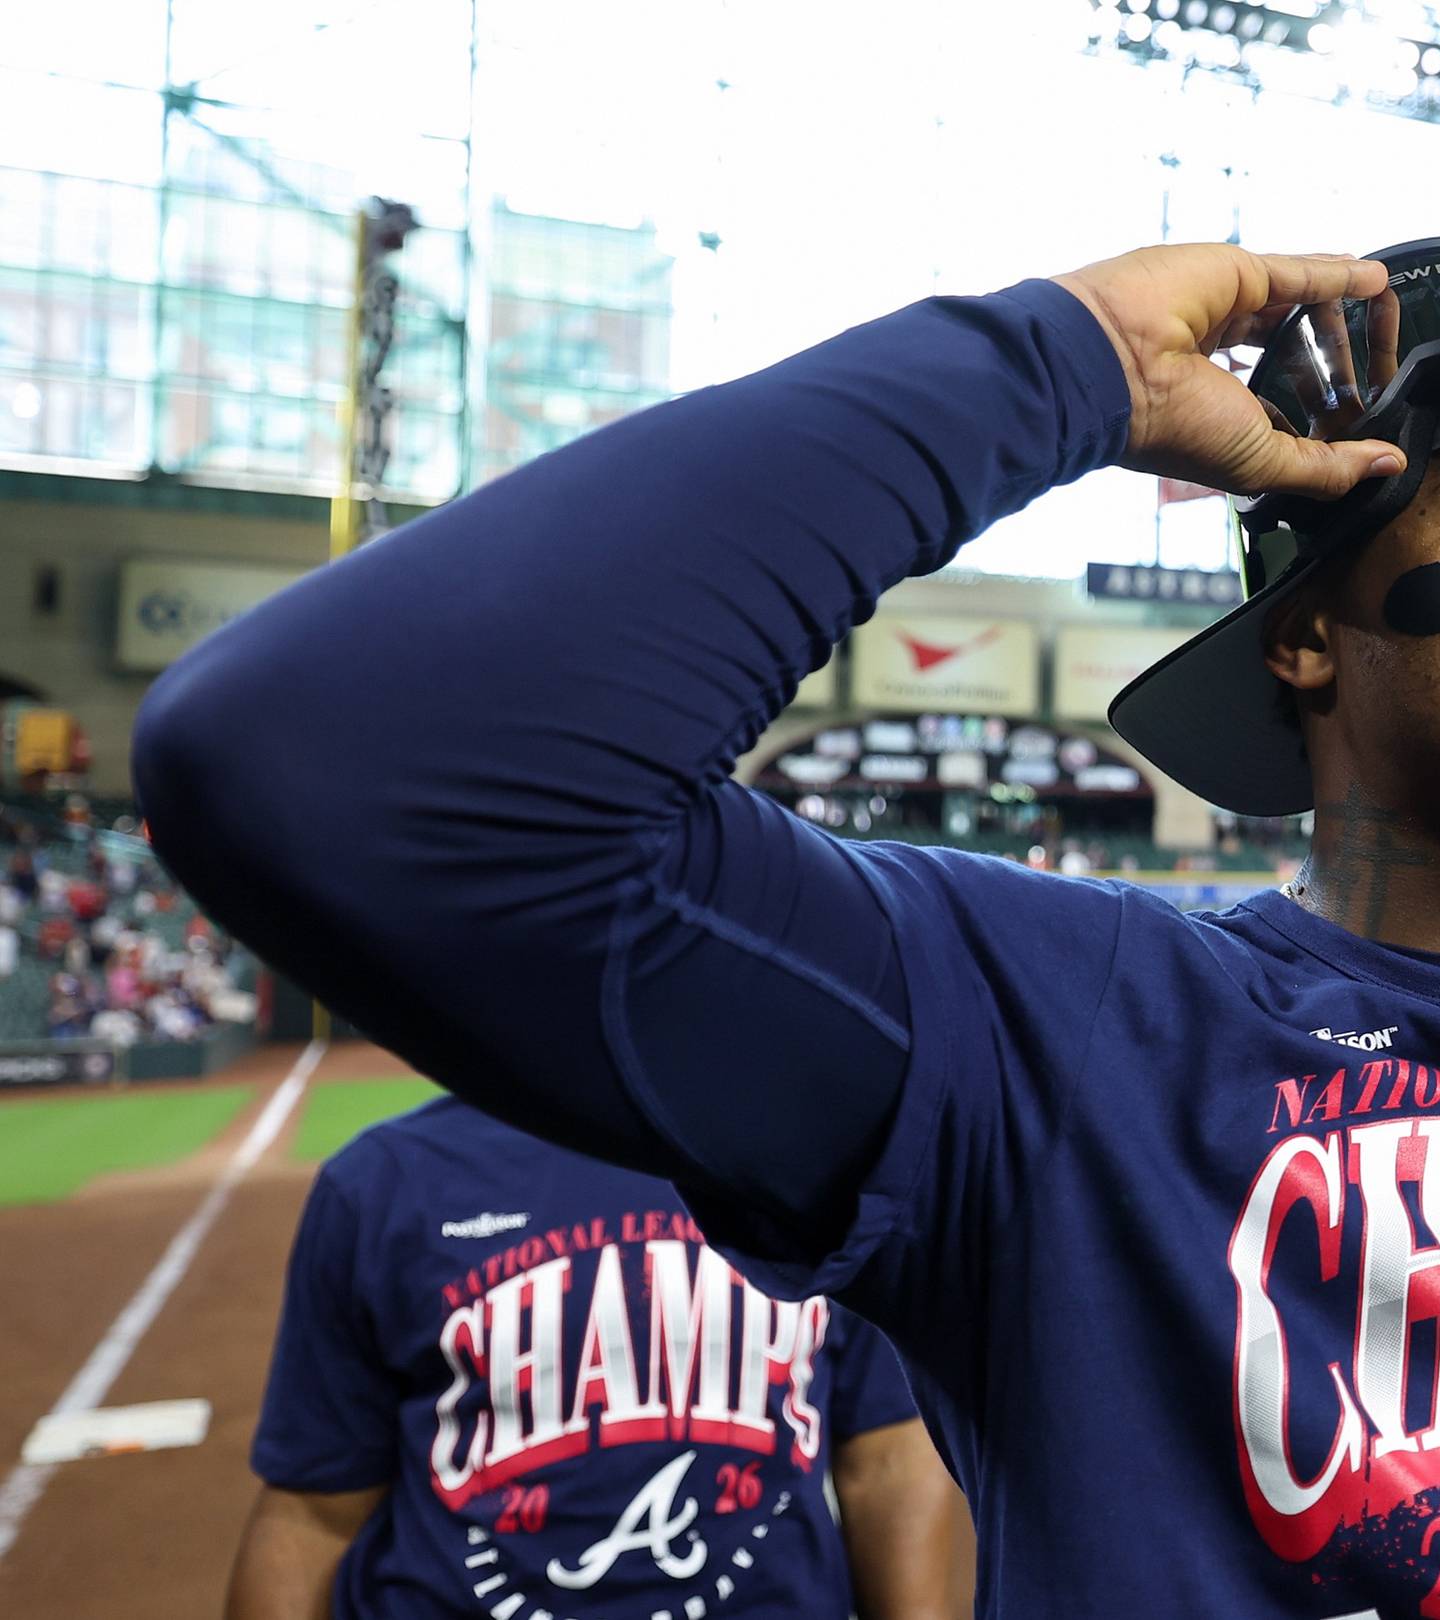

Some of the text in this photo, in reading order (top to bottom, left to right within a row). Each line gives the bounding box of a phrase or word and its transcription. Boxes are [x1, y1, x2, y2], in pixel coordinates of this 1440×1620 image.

[1388, 265, 1431, 288] EW
[430, 1240, 830, 1490] CHAMPS
[494, 1462, 764, 1535] 20 26
